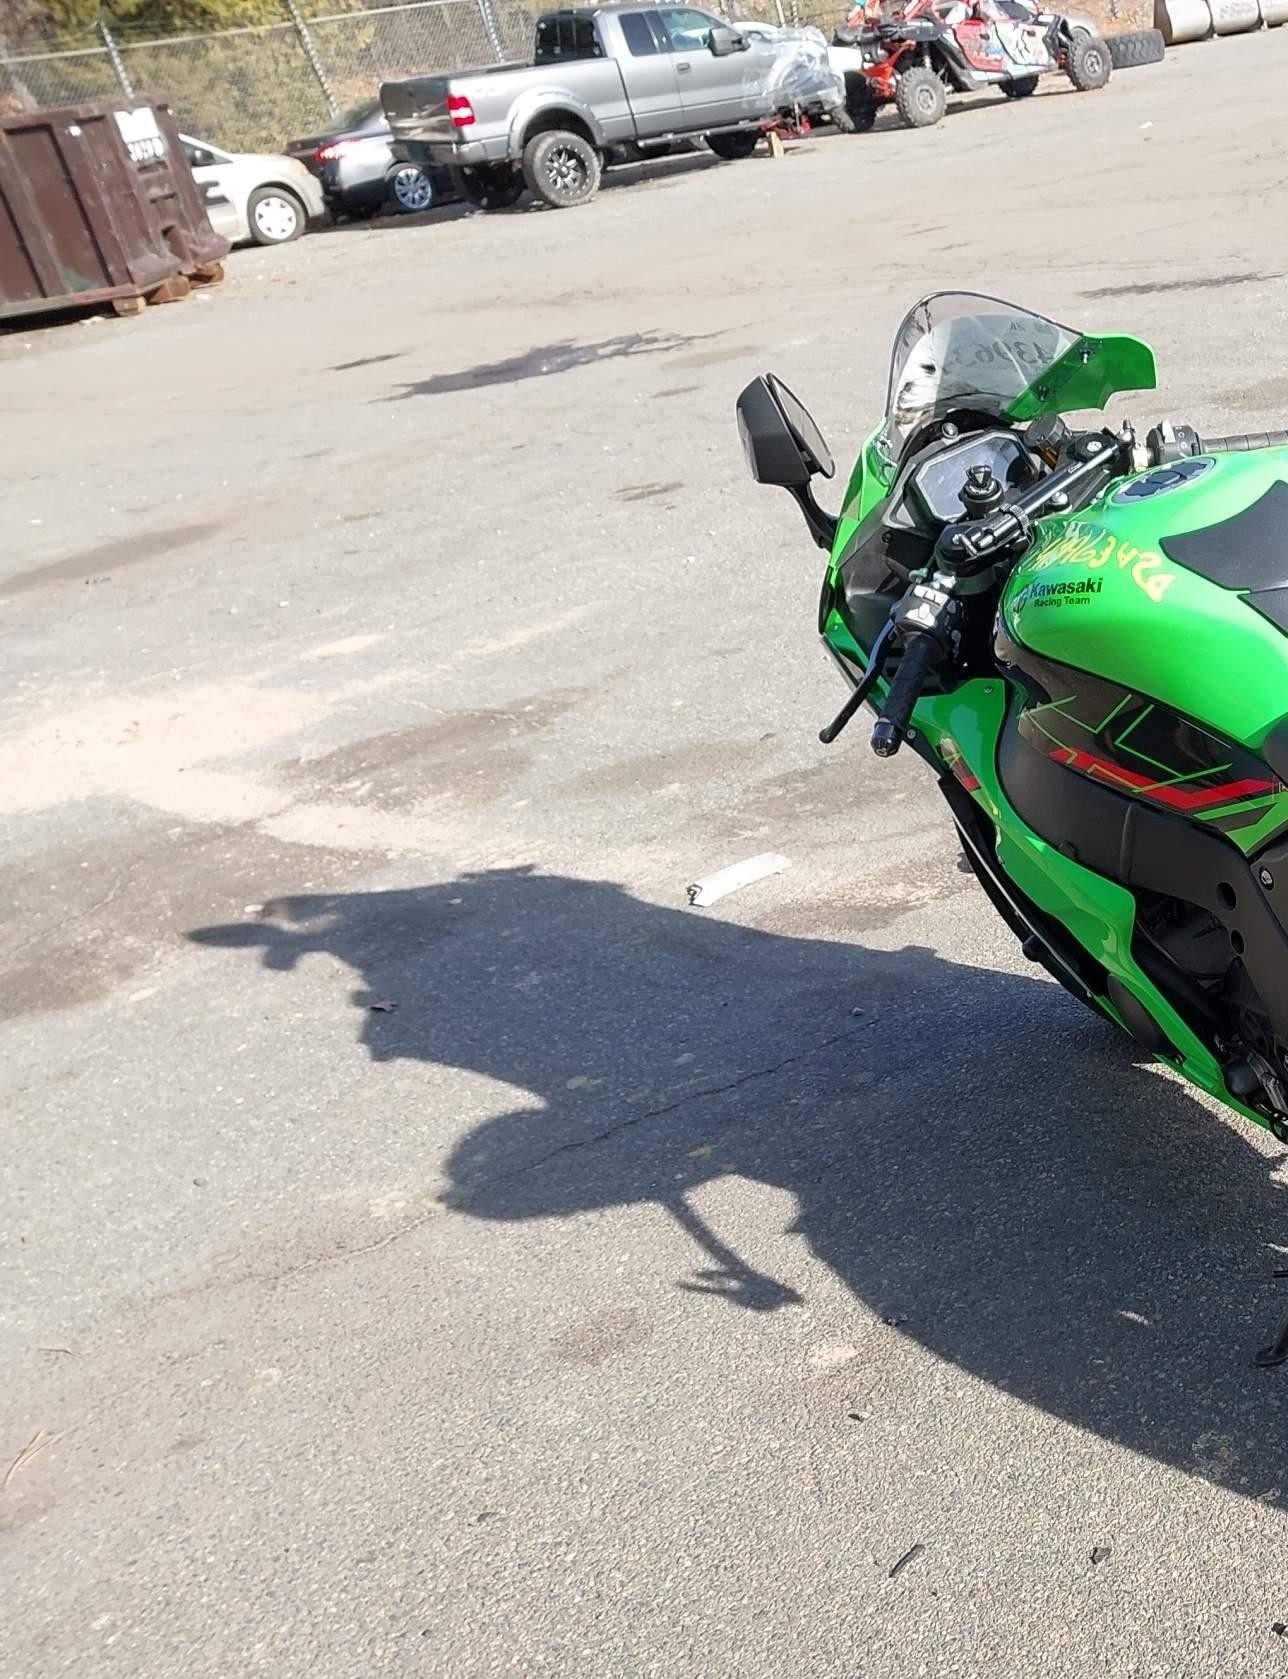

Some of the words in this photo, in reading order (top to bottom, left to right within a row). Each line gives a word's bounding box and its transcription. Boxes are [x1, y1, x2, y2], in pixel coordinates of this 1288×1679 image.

[1030, 578, 1104, 598] Kawasaki
[1033, 597, 1062, 608] Racing
[1063, 595, 1090, 606] Team
